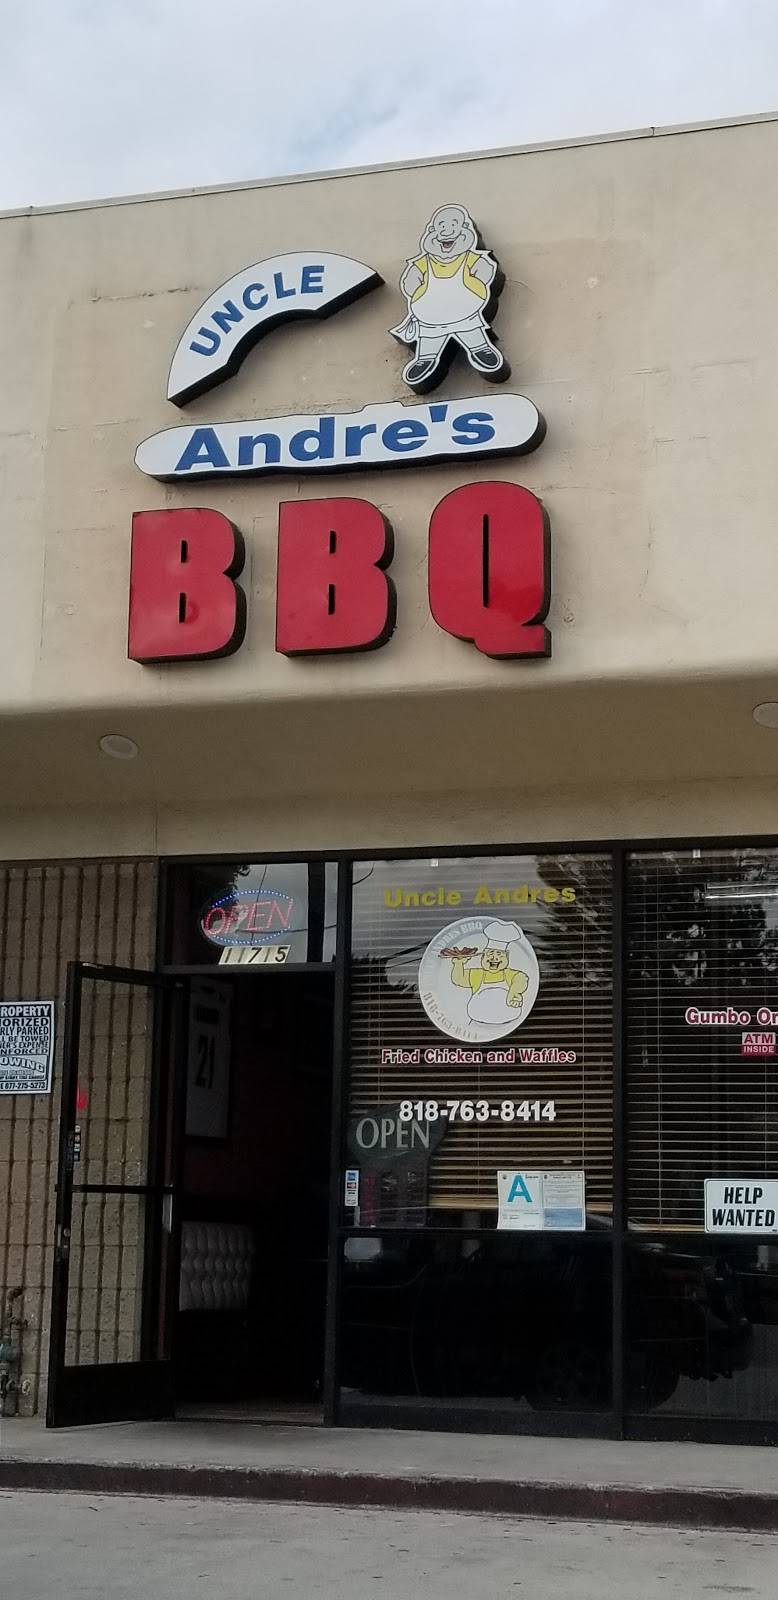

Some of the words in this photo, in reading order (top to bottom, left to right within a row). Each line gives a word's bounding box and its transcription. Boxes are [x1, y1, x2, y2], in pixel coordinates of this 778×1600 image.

[189, 265, 325, 357] UNCLE
[174, 405, 496, 471] Andre's
[128, 481, 551, 662] BBQ
[384, 887, 462, 907] Uncle
[474, 885, 577, 904] Andres
[203, 899, 293, 934] OPEN
[225, 947, 288, 962] 11715
[1, 1006, 50, 1017] ROPERTY
[685, 1007, 751, 1025] Gumbo
[0, 1027, 15, 1035] RLY
[17, 1026, 48, 1035] PARKED
[744, 1034, 773, 1043] ATM
[381, 1050, 420, 1063] Fried
[424, 1049, 482, 1063] Chicken
[488, 1049, 515, 1063] and
[519, 1048, 577, 1063] Waffles
[400, 1100, 556, 1121] 818-763-8414
[355, 1118, 430, 1149] OPEN
[506, 1174, 532, 1203] A
[724, 1187, 763, 1204] HELP
[712, 1209, 775, 1226] WANTED
